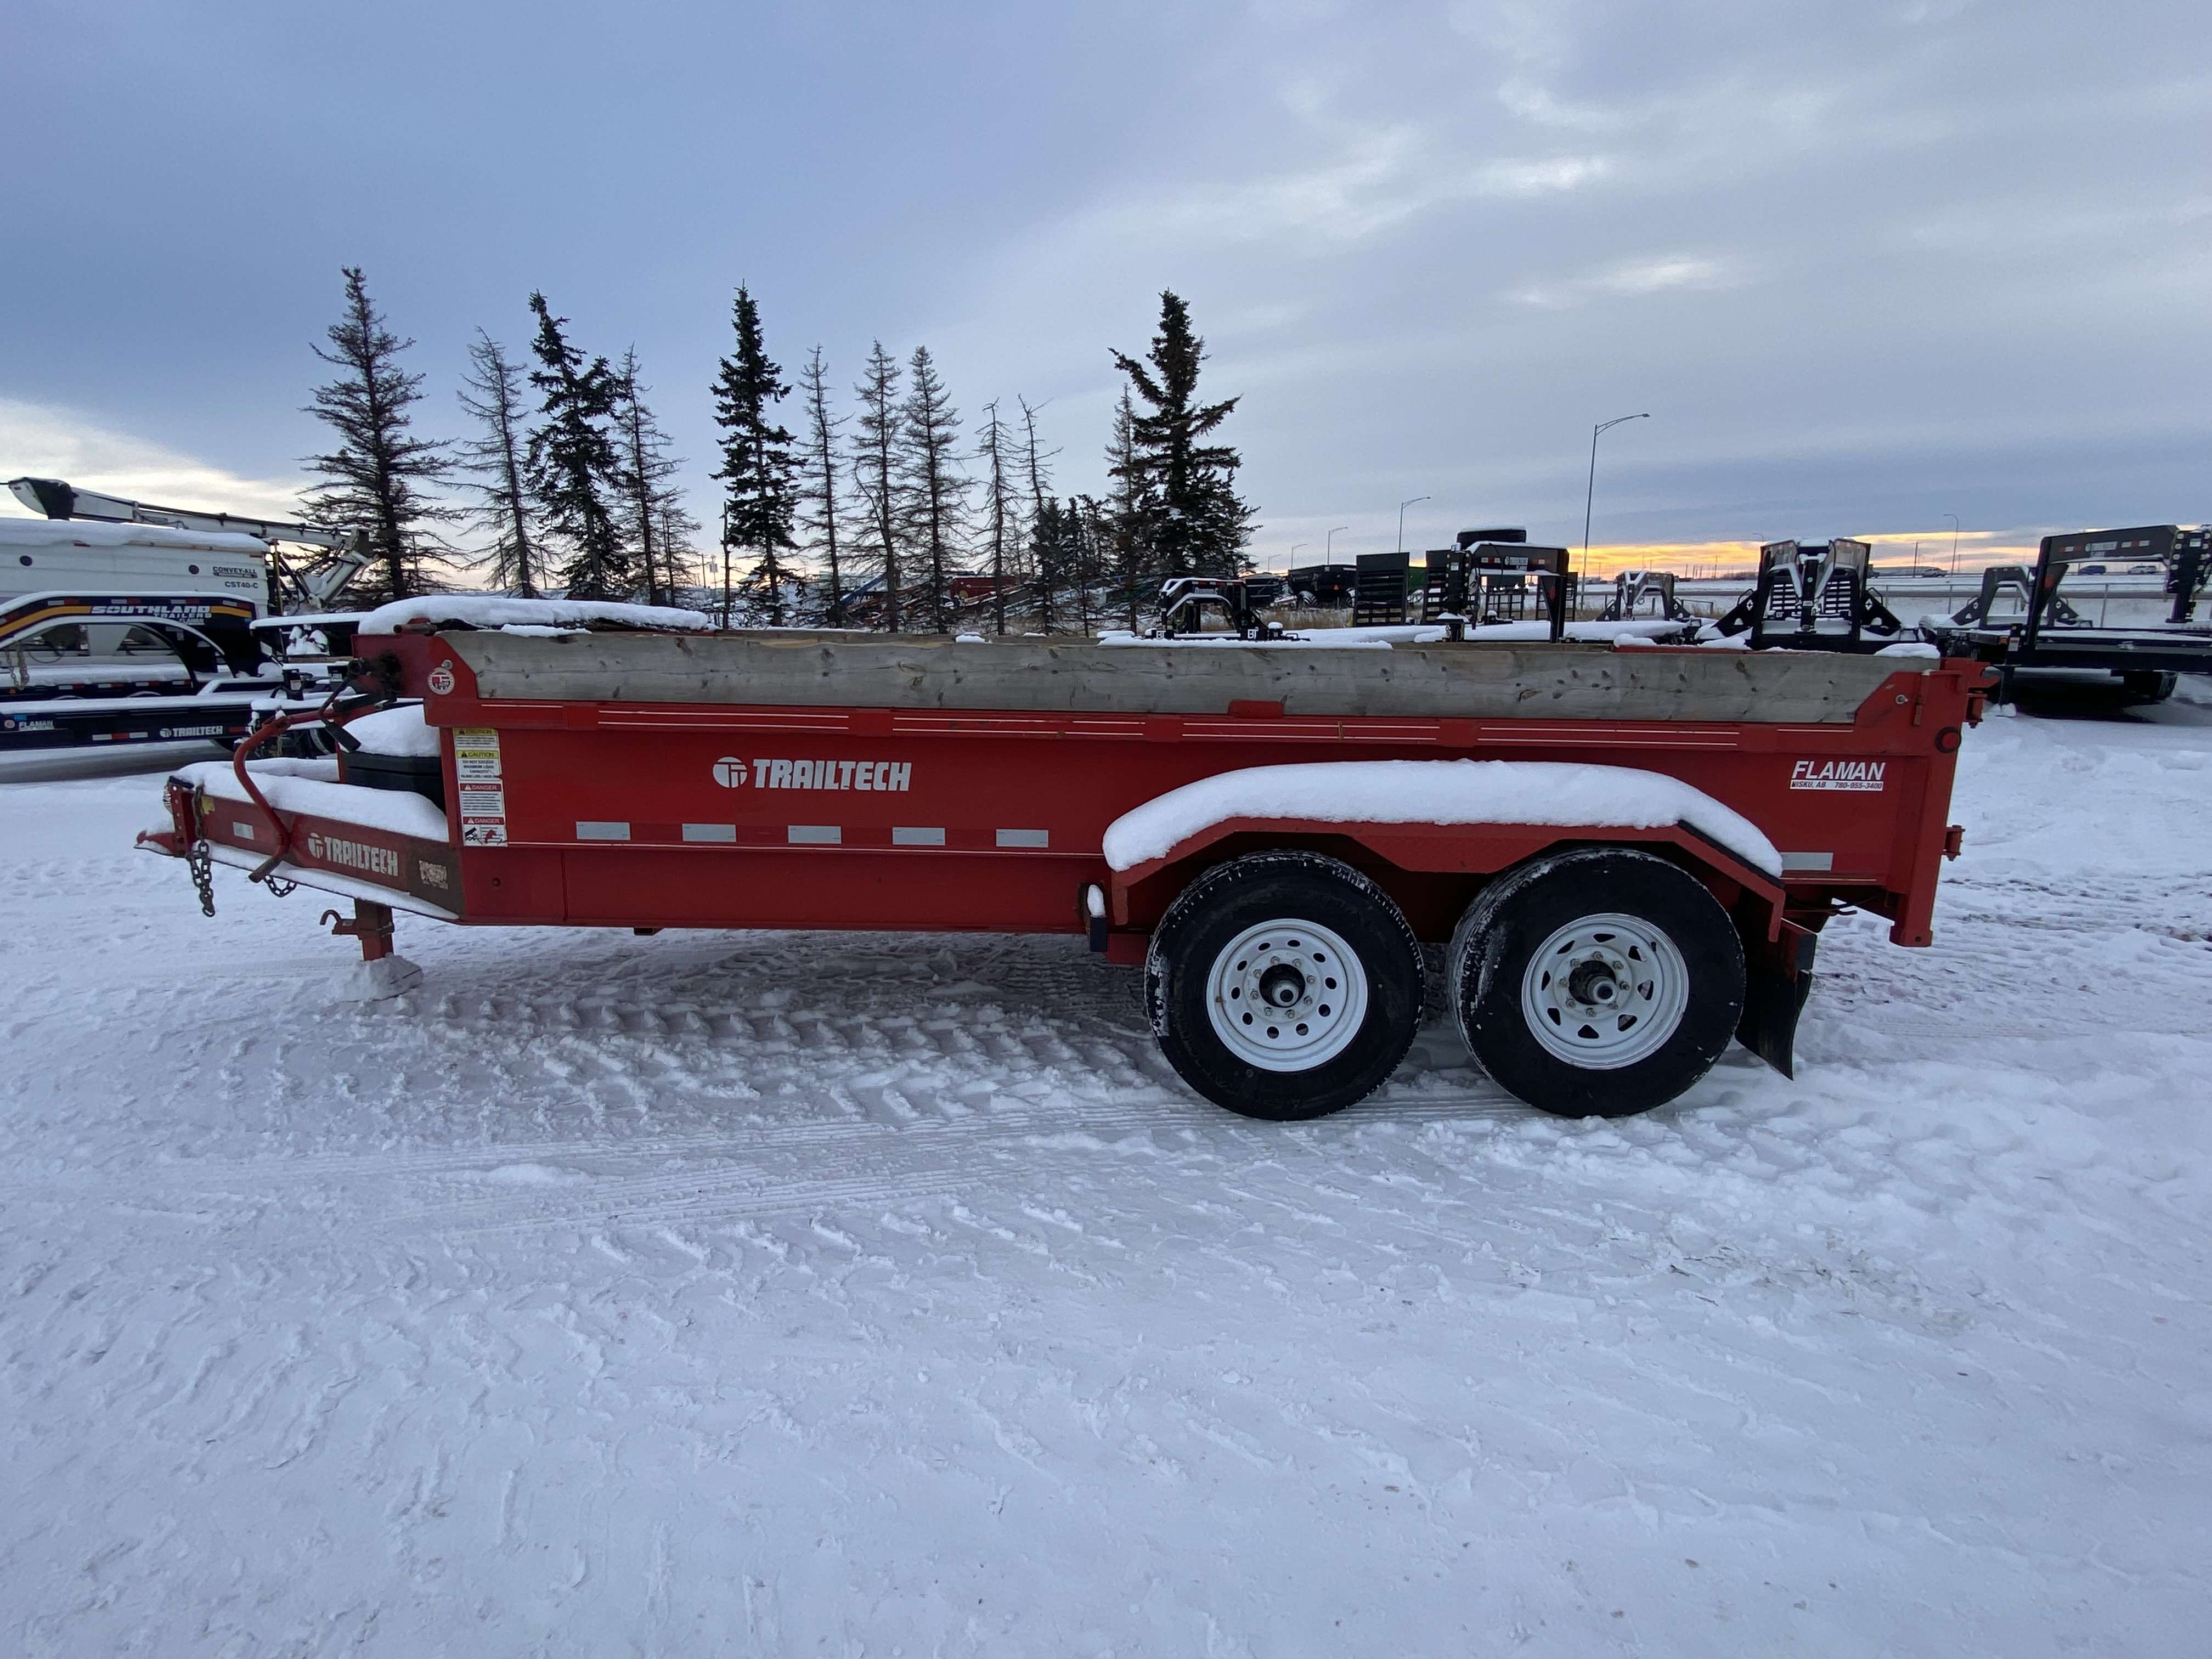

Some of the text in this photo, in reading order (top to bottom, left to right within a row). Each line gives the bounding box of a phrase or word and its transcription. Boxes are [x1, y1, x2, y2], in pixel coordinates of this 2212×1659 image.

[91, 606, 212, 614] SOUTHLAND
[173, 725, 223, 737] TRAILTECH
[753, 759, 912, 792] TRAILTECH
[1791, 761, 1886, 781] FLAMAN
[324, 836, 398, 877] TRAILTECH
